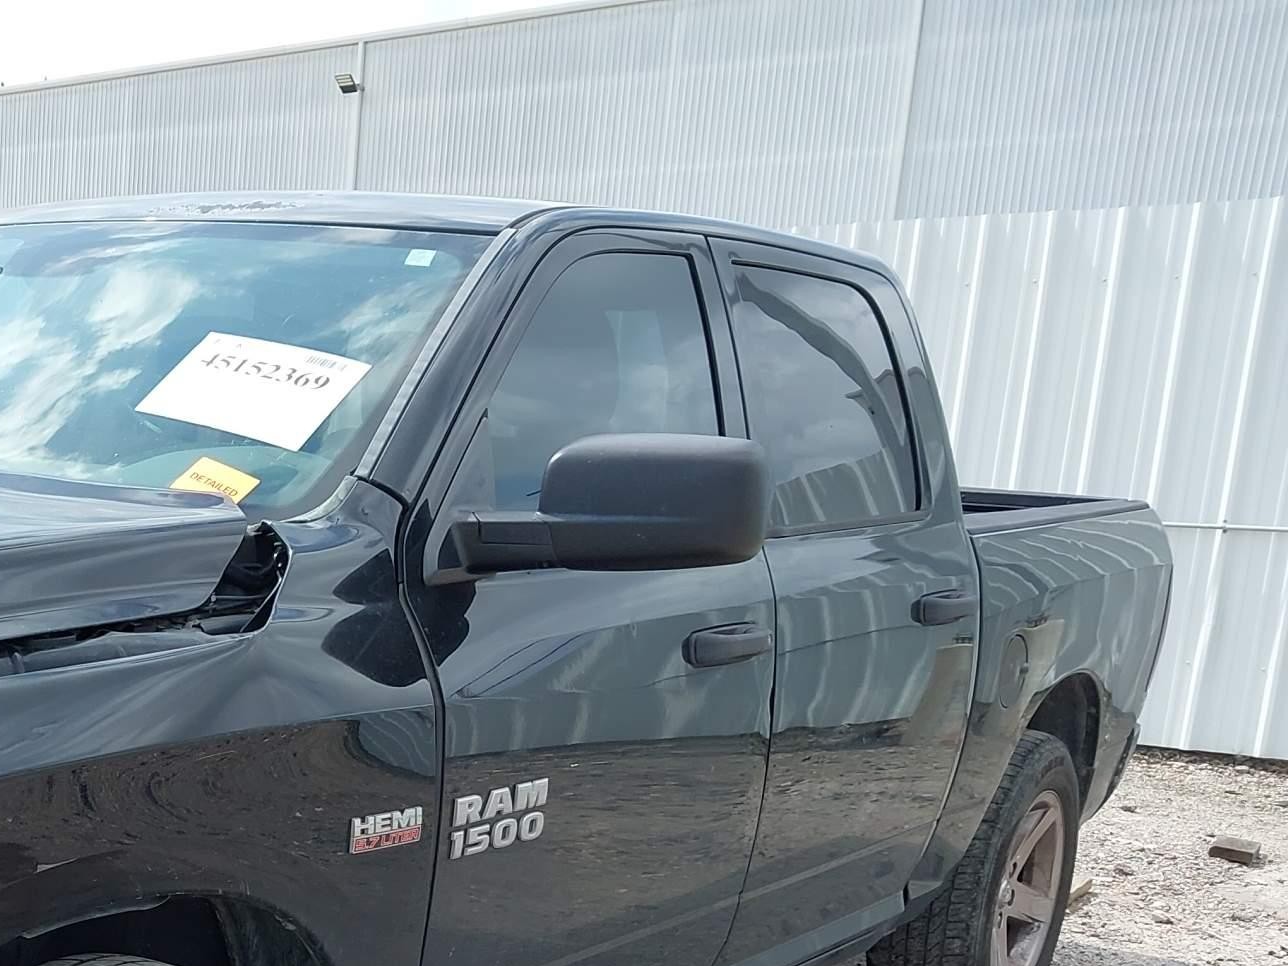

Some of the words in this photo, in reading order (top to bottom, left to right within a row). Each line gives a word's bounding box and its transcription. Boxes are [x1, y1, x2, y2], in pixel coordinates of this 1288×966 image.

[200, 352, 330, 390] 45152369
[190, 471, 238, 497] DETAILED
[452, 777, 549, 827] RAM
[351, 806, 424, 838] HEMI
[355, 835, 380, 851] 5.7
[380, 827, 420, 847] LITER
[449, 811, 545, 860] 1500
